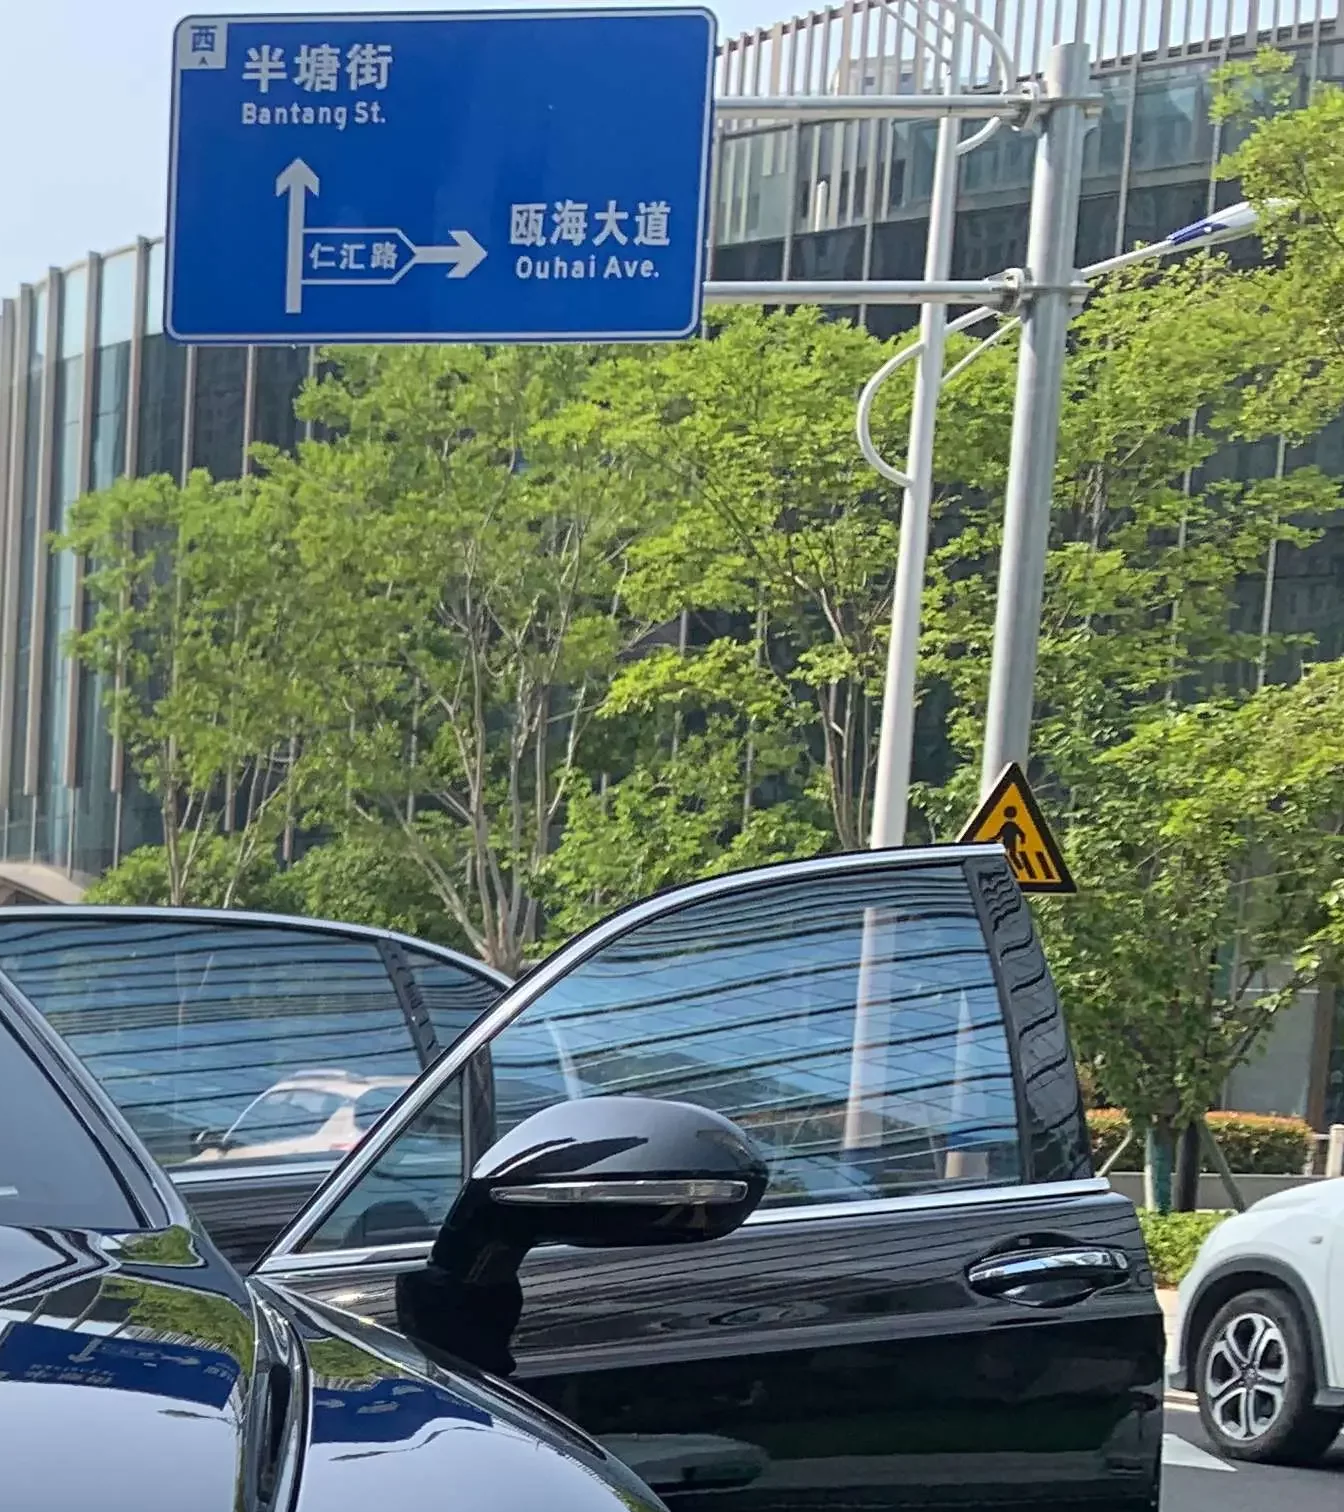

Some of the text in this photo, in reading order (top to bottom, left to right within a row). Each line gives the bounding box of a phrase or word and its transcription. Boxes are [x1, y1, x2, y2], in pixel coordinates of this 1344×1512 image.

[191, 25, 218, 53] 西
[242, 44, 394, 93] 半塘街
[242, 101, 386, 130] Bantang St.
[509, 199, 671, 247] 瓯海大道
[309, 242, 398, 270] 仁汇路
[516, 254, 660, 279] Ouhai Ave.
